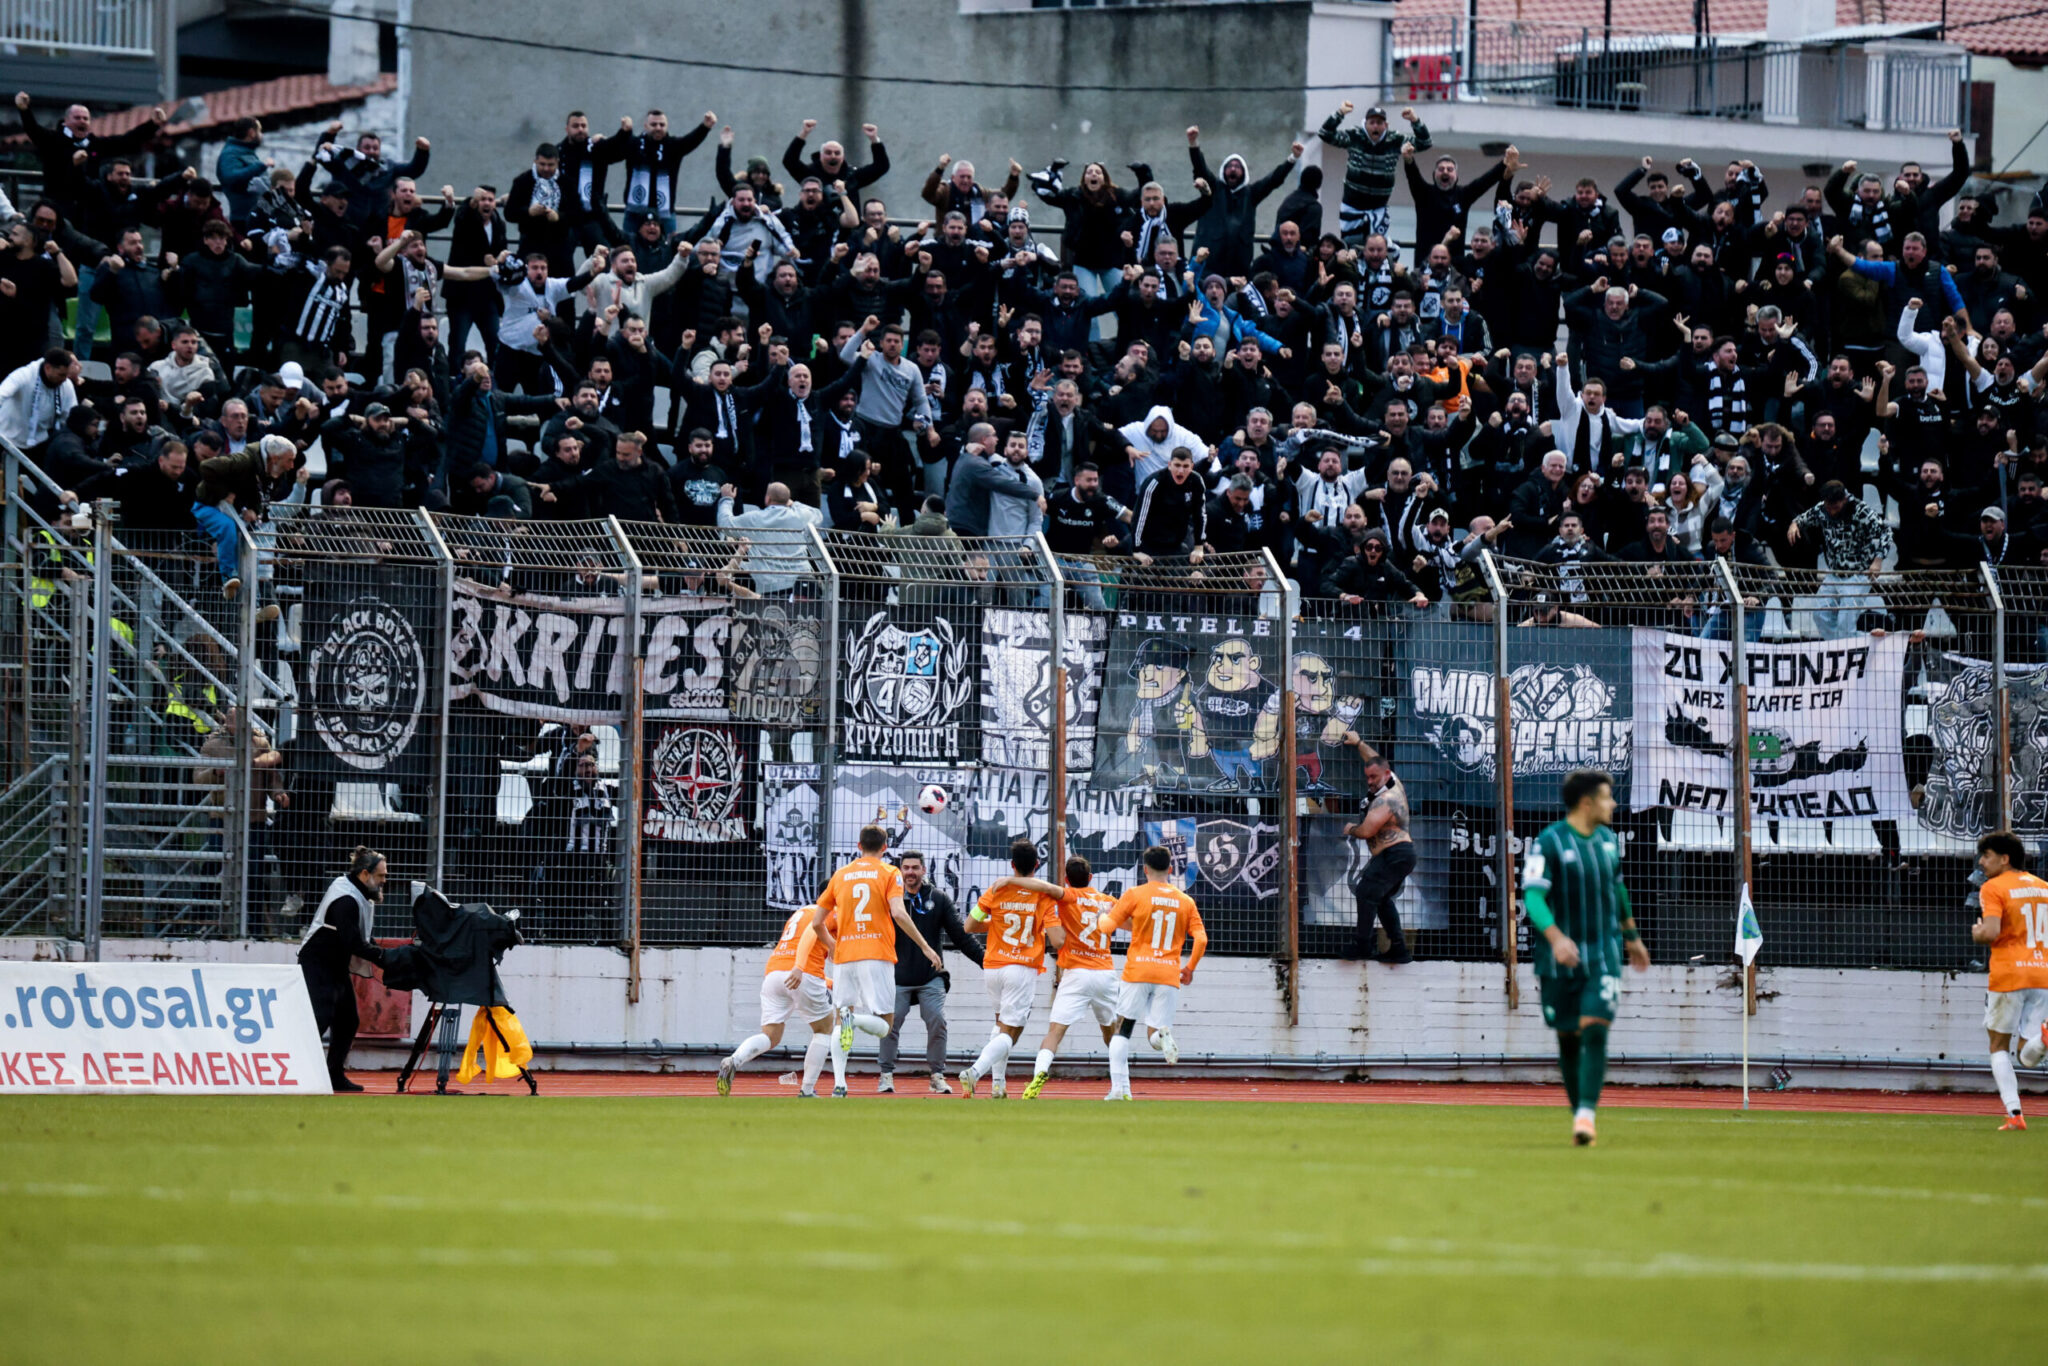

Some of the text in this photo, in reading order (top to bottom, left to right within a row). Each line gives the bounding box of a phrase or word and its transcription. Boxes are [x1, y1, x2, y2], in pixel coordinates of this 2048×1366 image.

[324, 611, 410, 658] BLACK BOYS
[983, 608, 1107, 640] MESSRA
[1343, 625, 1363, 641] 4
[1665, 643, 1703, 682] 20
[876, 679, 897, 714] 4
[1683, 687, 1843, 712] ΜΑΣ ΙΛΑΤΕ ΓΙΑ
[769, 769, 837, 786] ULTRA
[852, 883, 873, 922] 2
[841, 932, 883, 942] BIANCHET
[1151, 909, 1177, 951] 11
[2020, 902, 2048, 948] 14
[4, 968, 278, 1045] .rotosal.gr
[83, 1052, 298, 1086] ΔΕΞΑΜΕΝΕΣ
